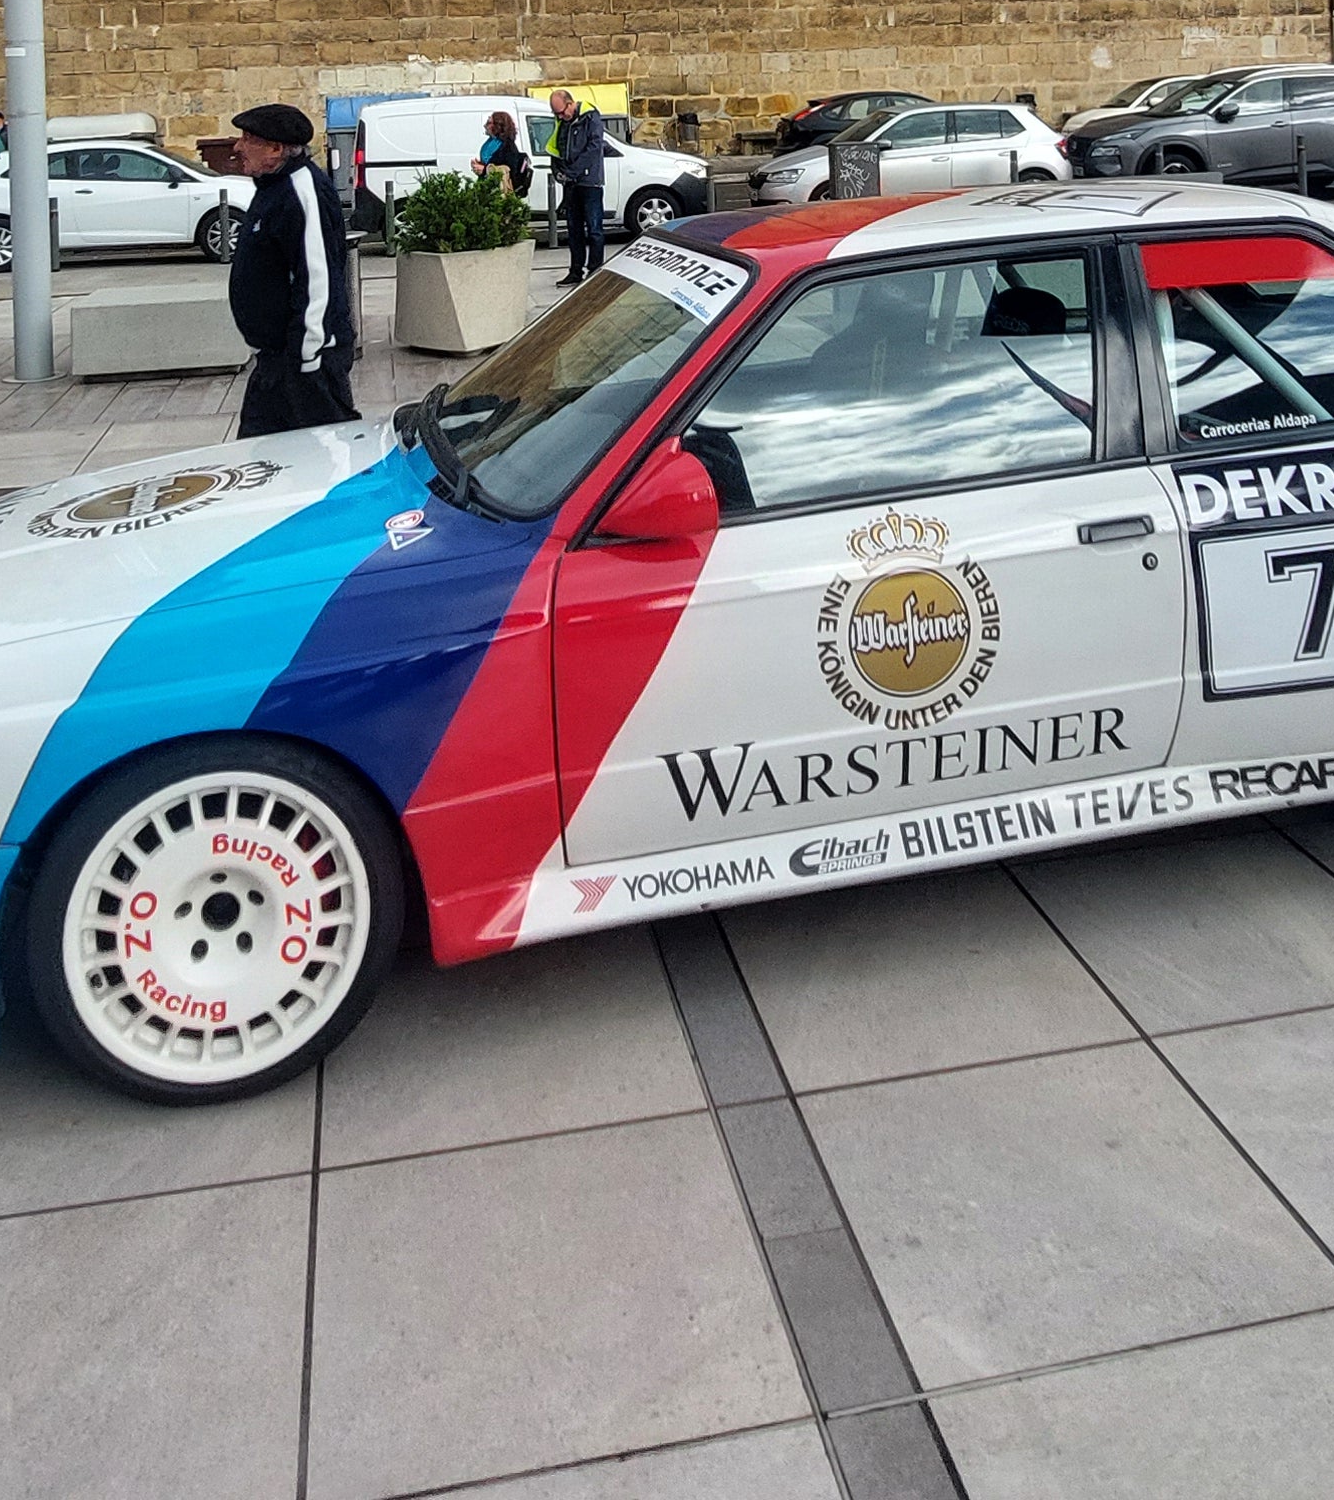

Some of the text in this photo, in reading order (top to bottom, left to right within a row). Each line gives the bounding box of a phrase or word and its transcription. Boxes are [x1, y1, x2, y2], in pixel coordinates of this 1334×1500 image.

[1200, 412, 1318, 439] Carrocerias Aldapa
[817, 553, 1001, 731] EINE KÖNIGIN UNTER DEN BIEREN
[851, 589, 969, 669] Warsteiner
[655, 706, 1132, 823] WARSTEINER
[898, 798, 1057, 860] BILSTEIN
[1066, 774, 1194, 829] TEVES
[211, 832, 301, 888] Racing
[622, 855, 776, 902] YOKOHAMA
[788, 828, 891, 878] Eibach
[136, 968, 228, 1023] Racing
